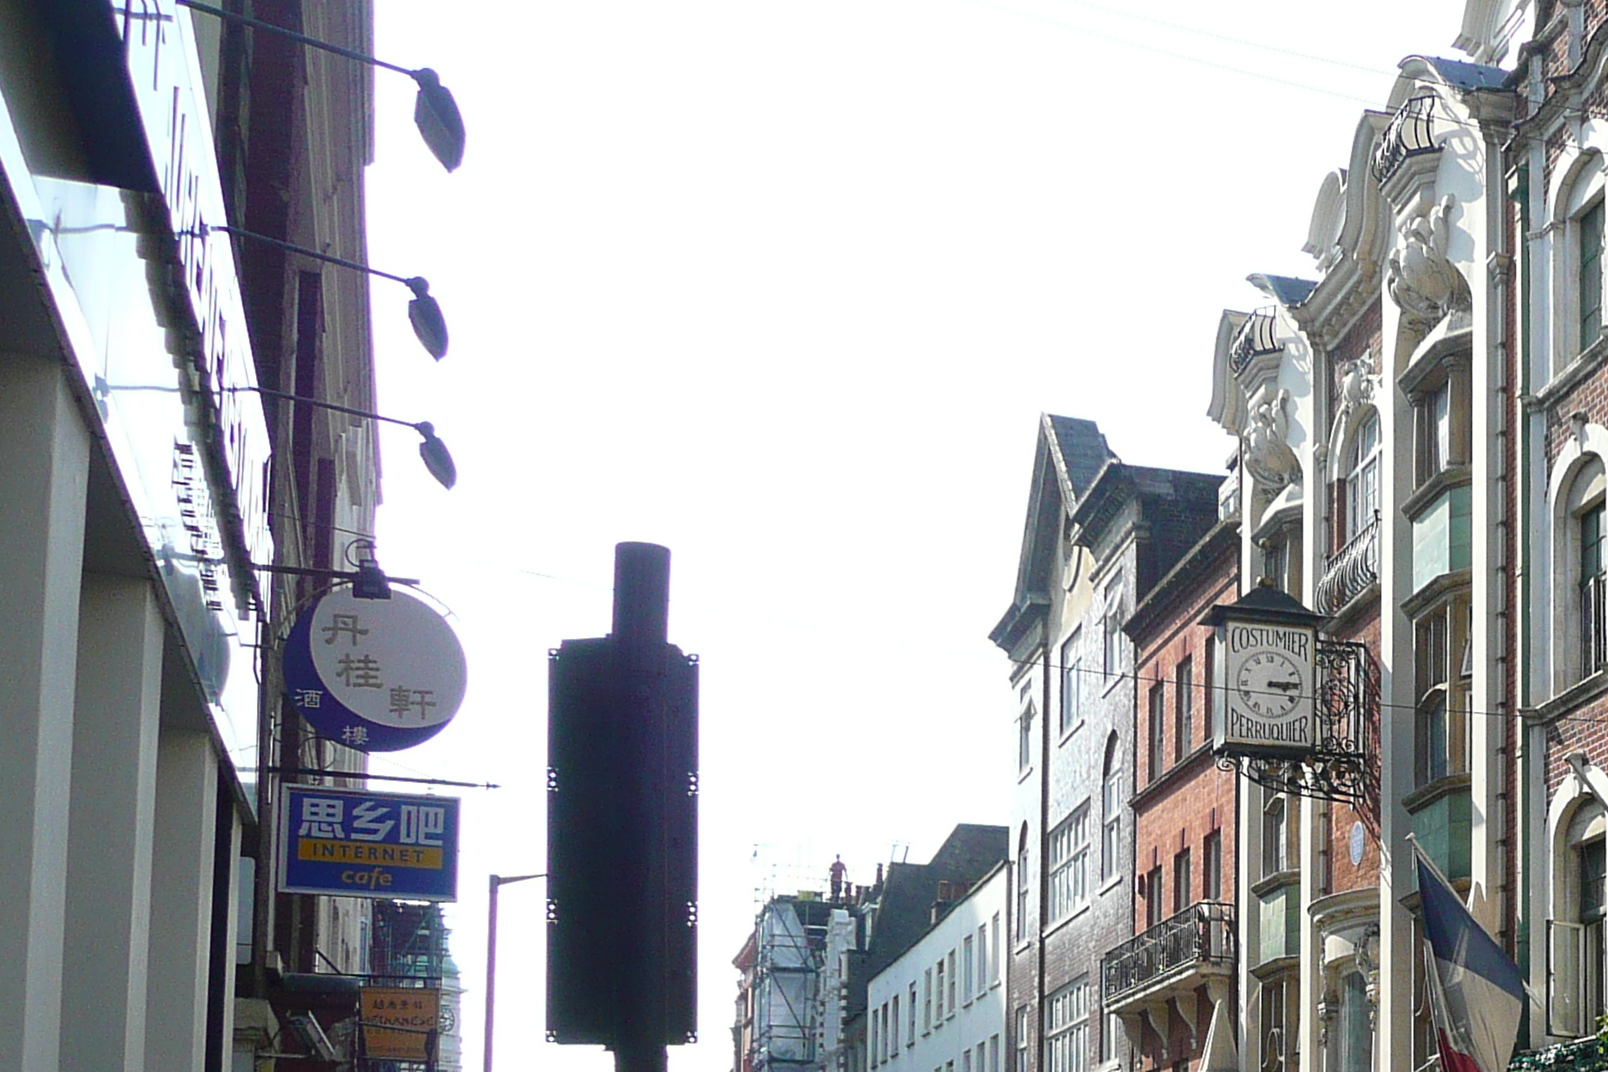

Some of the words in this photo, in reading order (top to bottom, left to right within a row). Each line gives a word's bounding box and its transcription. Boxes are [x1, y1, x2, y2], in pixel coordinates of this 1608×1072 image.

[1231, 626, 1309, 662] COSTUMIER
[1230, 706, 1309, 743] PERRUQUIER
[298, 797, 446, 846] 思乡吧
[311, 842, 424, 864] INTERNET
[341, 865, 393, 890] cafe
